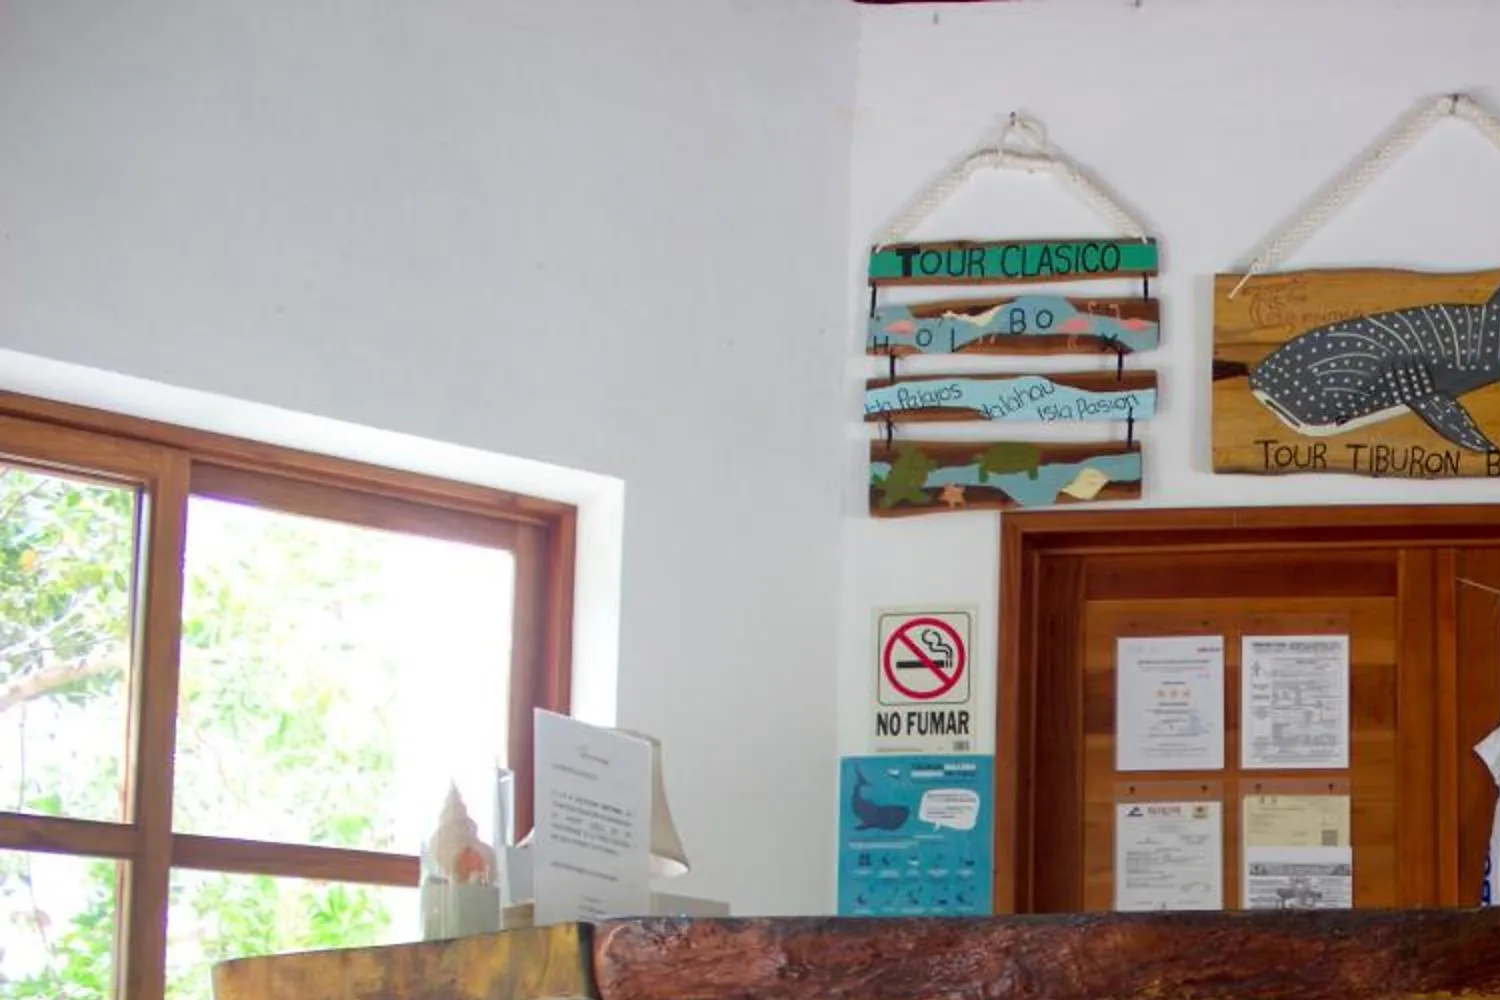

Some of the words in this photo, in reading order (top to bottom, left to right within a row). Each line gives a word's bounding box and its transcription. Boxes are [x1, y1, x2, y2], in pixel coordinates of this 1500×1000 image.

[896, 246, 985, 277] TOUR
[1000, 243, 1121, 277] CLASICO
[1254, 439, 1327, 470] TOUR
[1346, 443, 1460, 476] TIBURON
[876, 711, 901, 736] NO
[906, 709, 970, 736] FUMAR
